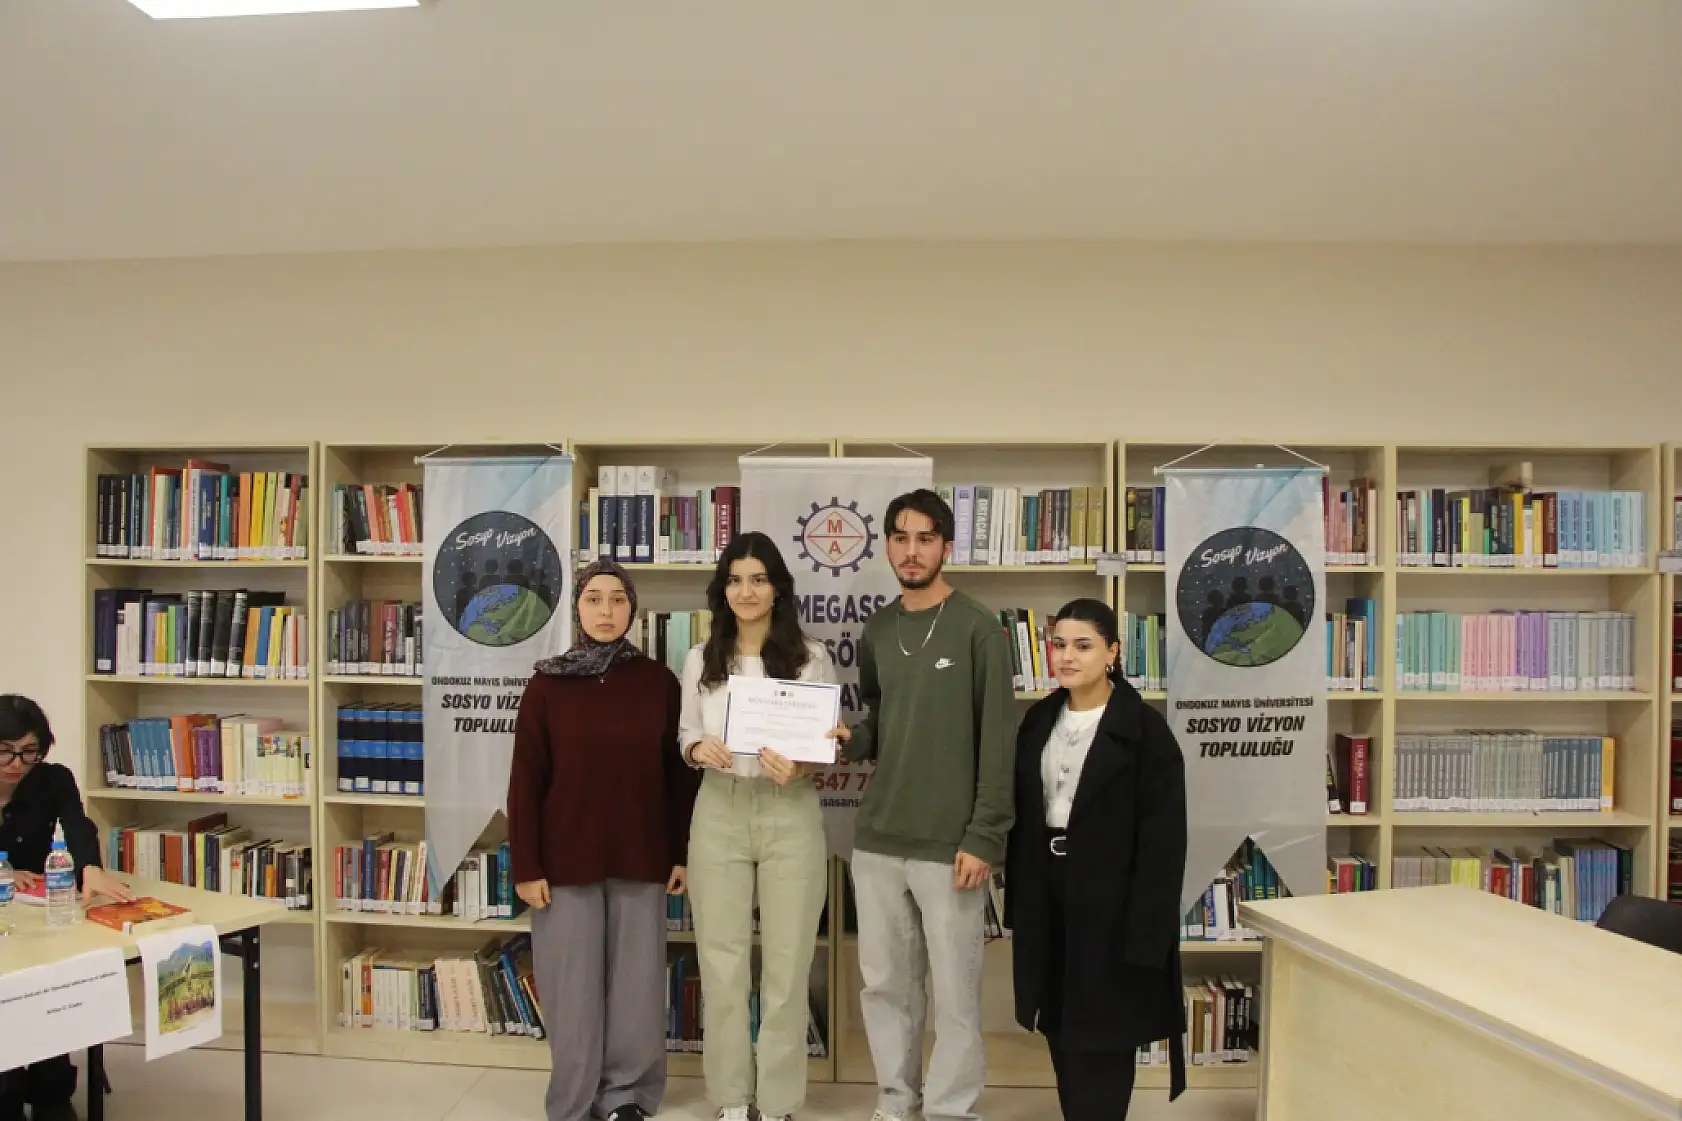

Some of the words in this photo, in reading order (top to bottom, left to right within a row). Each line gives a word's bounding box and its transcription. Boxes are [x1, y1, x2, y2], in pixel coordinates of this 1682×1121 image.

[827, 519, 842, 533] M
[456, 528, 494, 550] Sosyo
[496, 527, 537, 549] Vizyon
[828, 540, 843, 555] A
[1201, 545, 1243, 568] Sosyo
[1244, 544, 1289, 566] Vizyon
[431, 676, 472, 686] ONDOKUZ
[441, 693, 493, 710] SOSYO
[496, 690, 521, 710] VİZ
[1175, 699, 1219, 710] ONDOKUZ
[1253, 695, 1314, 709] ÜNİVERSİTESİ
[1185, 716, 1242, 734] SOSYO
[1246, 711, 1306, 733] VİZYON
[1199, 736, 1295, 758] TOPLULUĞU
